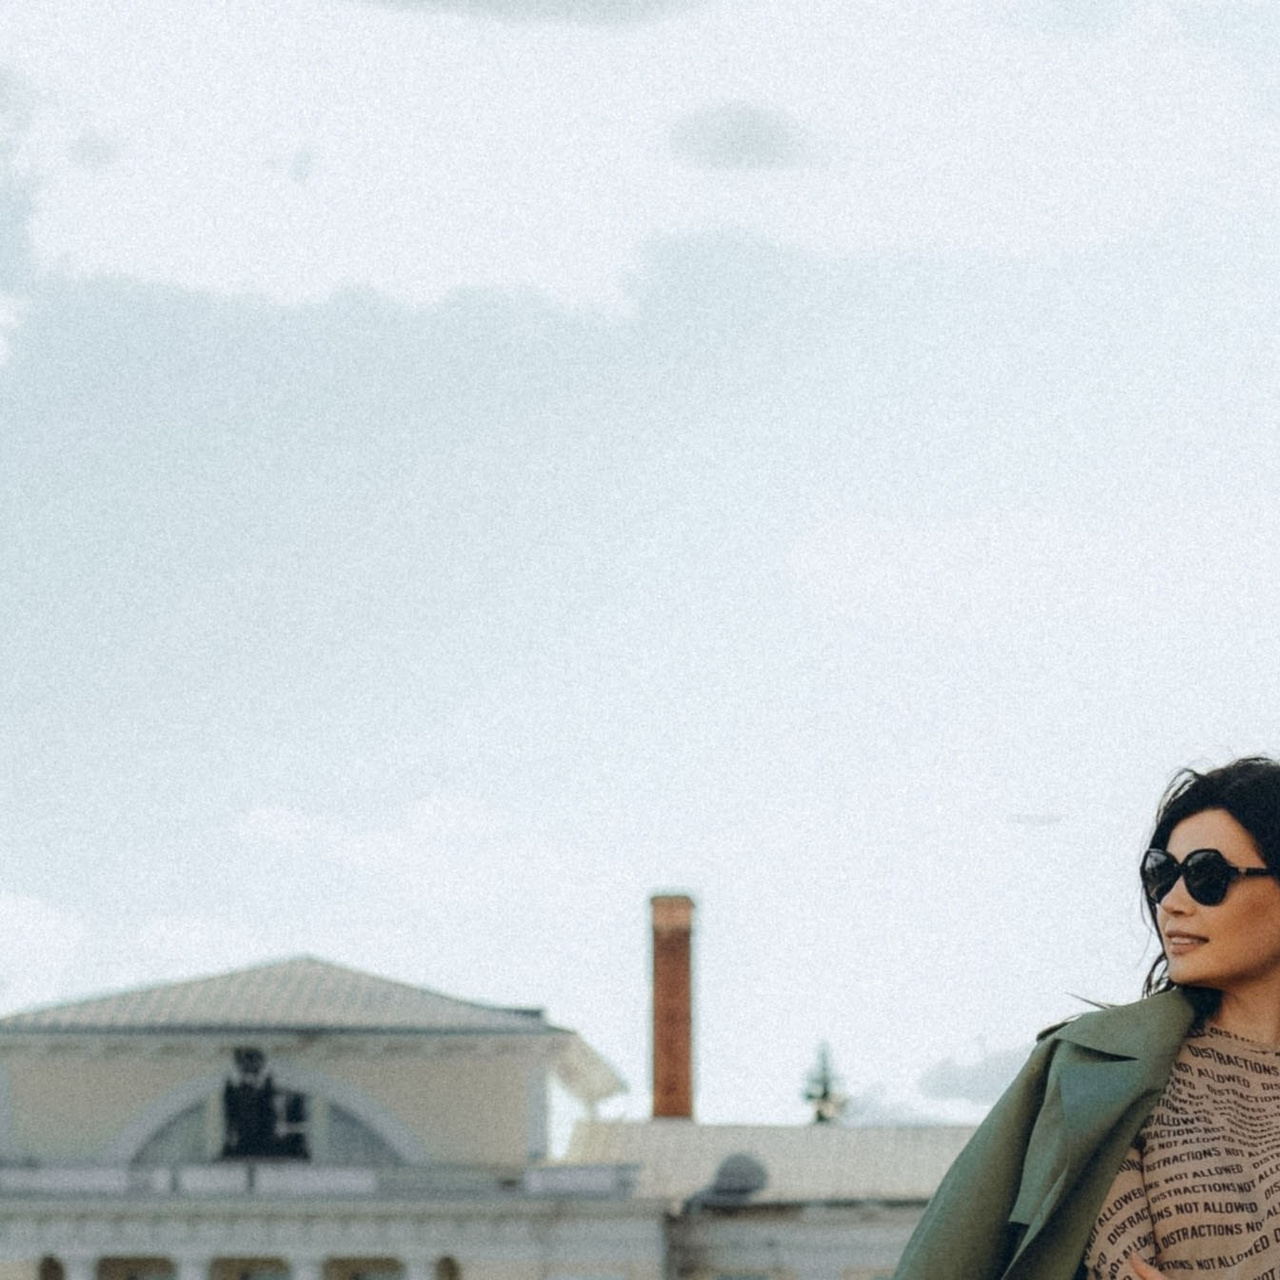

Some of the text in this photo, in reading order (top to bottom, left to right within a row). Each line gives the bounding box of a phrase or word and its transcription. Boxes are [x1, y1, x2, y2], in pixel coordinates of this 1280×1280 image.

[1187, 1044, 1279, 1076] DISTRACTIONS
[1197, 1067, 1251, 1088] ALLOWED
[1158, 1140, 1178, 1151] NOT
[1164, 1172, 1189, 1185] NOT
[1192, 1163, 1244, 1180] ALLOWED
[1151, 1181, 1237, 1204] DISTRACTIONS
[1236, 1179, 1257, 1194] NOT
[1097, 1186, 1146, 1229] ALLOWED
[1175, 1201, 1200, 1215] NOT
[1203, 1201, 1259, 1214] ALLOWED
[1161, 1222, 1244, 1250] DISTRACTIONS
[1196, 1258, 1217, 1271] NOT
[1218, 1233, 1271, 1270] ALLOWED
